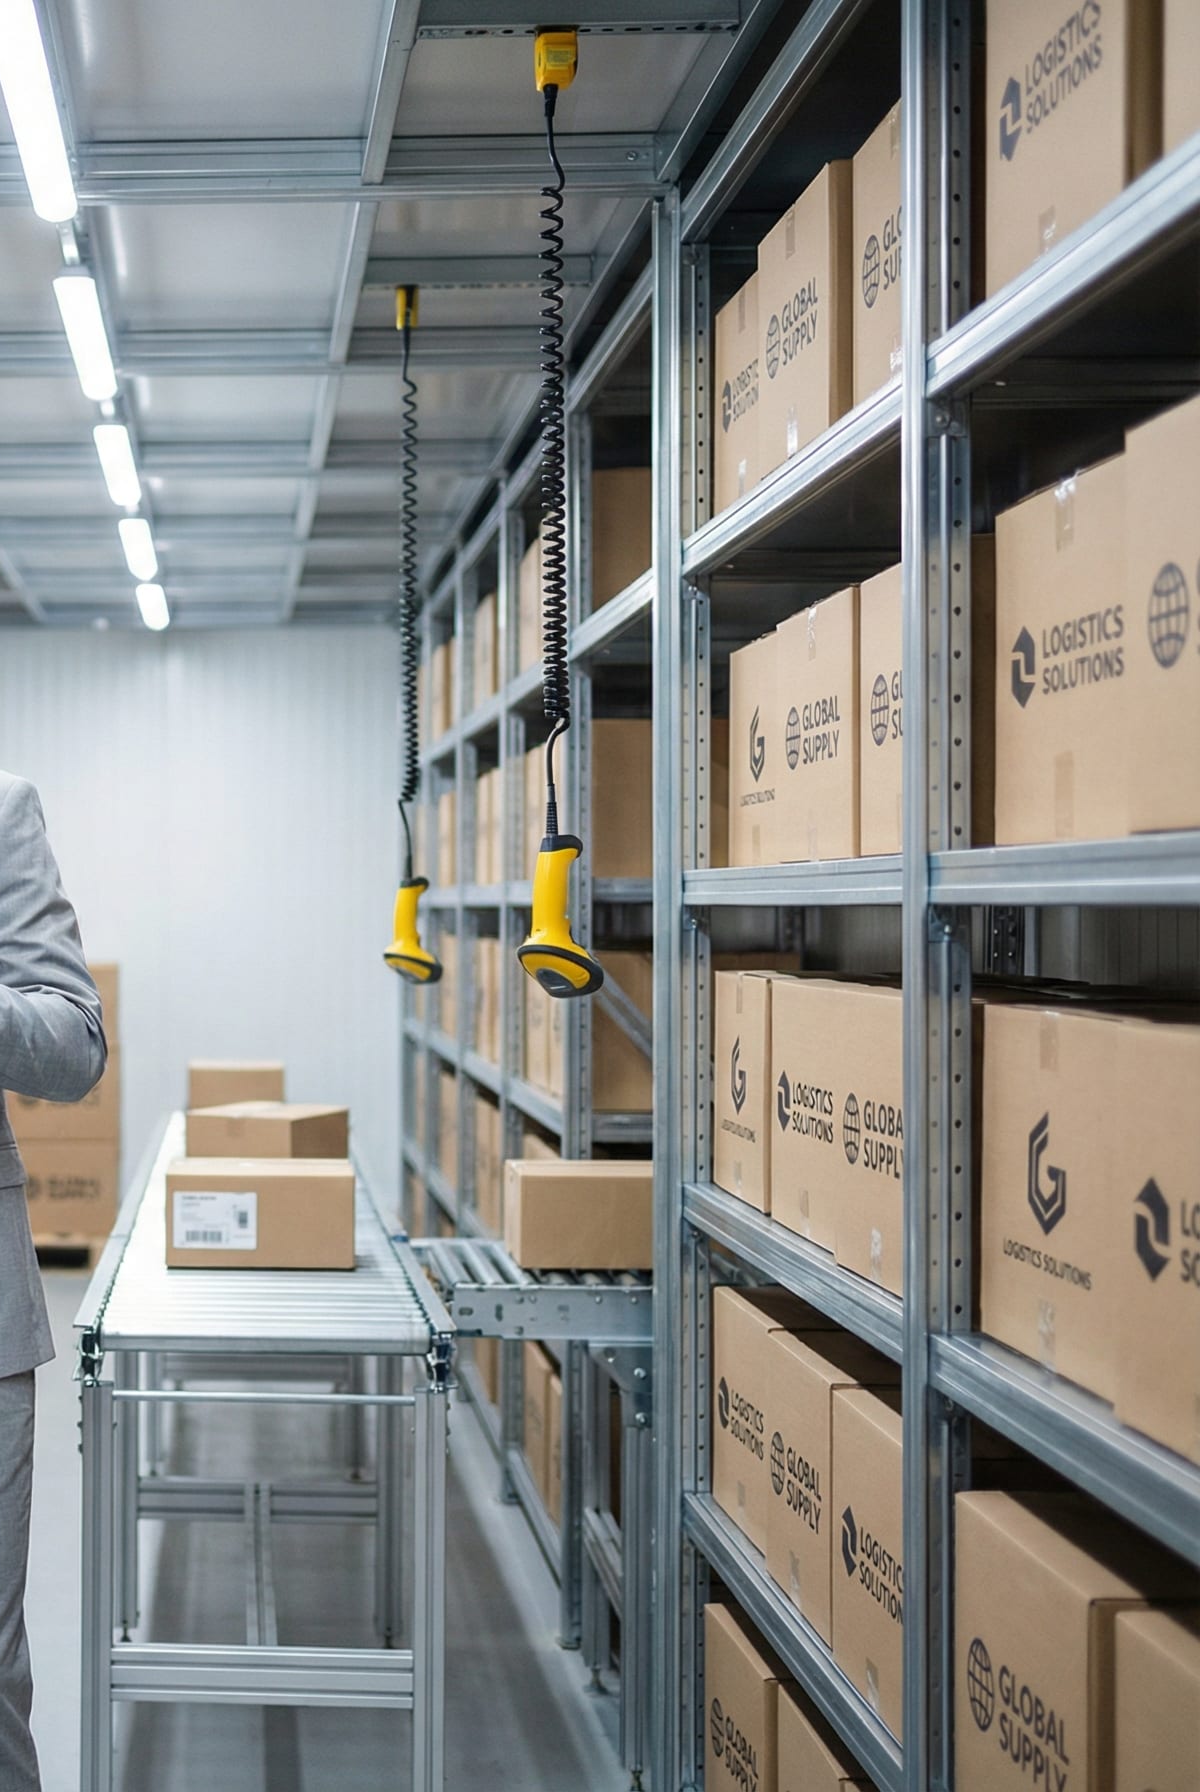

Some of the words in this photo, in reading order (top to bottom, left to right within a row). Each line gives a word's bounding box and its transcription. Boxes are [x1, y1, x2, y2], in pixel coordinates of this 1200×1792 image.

[1025, 0, 1101, 96] LOGISTICS
[1026, 34, 1103, 135] SOLUTIONS
[781, 277, 818, 334] GLOBAL
[782, 310, 818, 366] SUPPLY
[1042, 604, 1124, 659] LOGISTICS
[1042, 646, 1125, 695] SOLUTIONS
[802, 695, 841, 731] GLOBAL
[802, 729, 840, 765] SUPPLY
[792, 1081, 833, 1116] LOGISTICS
[863, 1099, 904, 1140] GLOBA
[863, 1137, 904, 1179] SUPPL
[786, 1446, 822, 1503] GLOBAL
[786, 1479, 821, 1535] SUPPLY
[860, 1526, 904, 1594] LOGISTIC
[999, 1665, 1070, 1766] GLOBAL
[726, 1715, 759, 1780] GLOBAL
